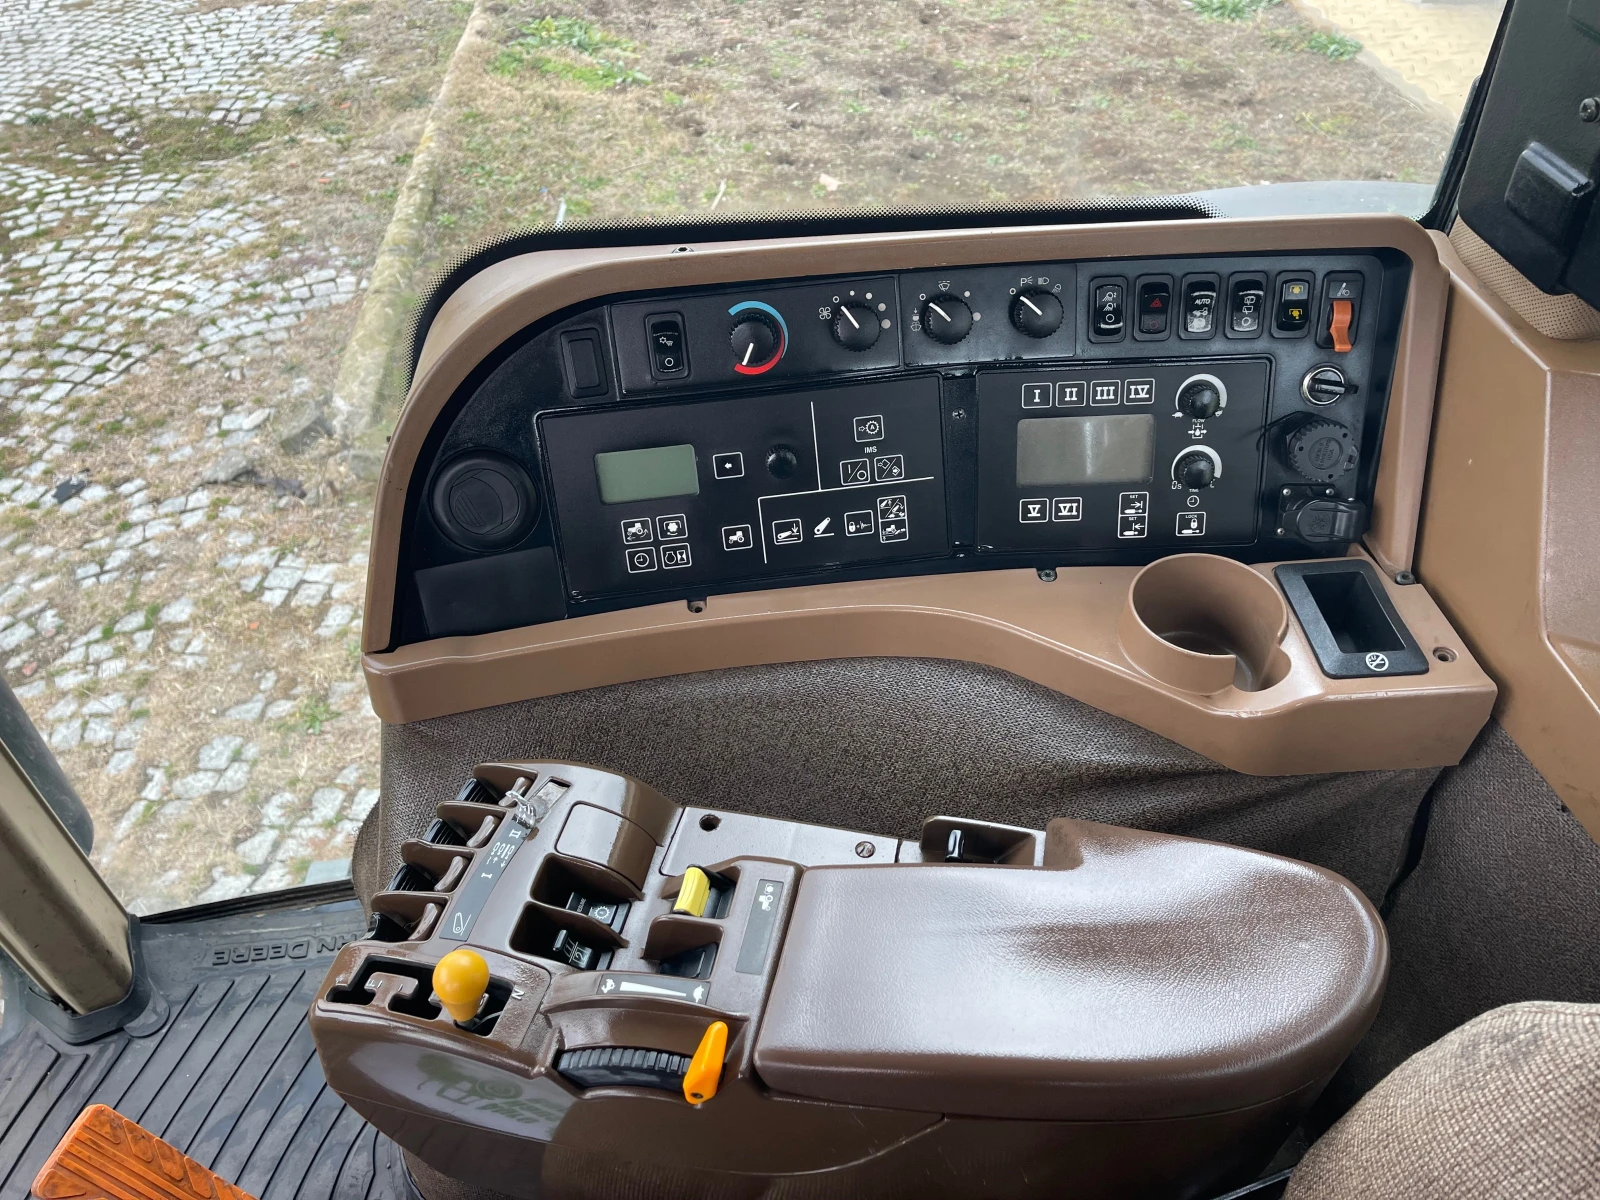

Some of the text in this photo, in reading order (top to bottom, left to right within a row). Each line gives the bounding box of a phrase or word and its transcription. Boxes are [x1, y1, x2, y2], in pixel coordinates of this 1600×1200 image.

[1033, 384, 1150, 403] I II III IV
[864, 445, 878, 454] IMS
[1027, 502, 1078, 517] V VI
[212, 934, 357, 966] HN DEERE
[511, 985, 525, 1000] N
